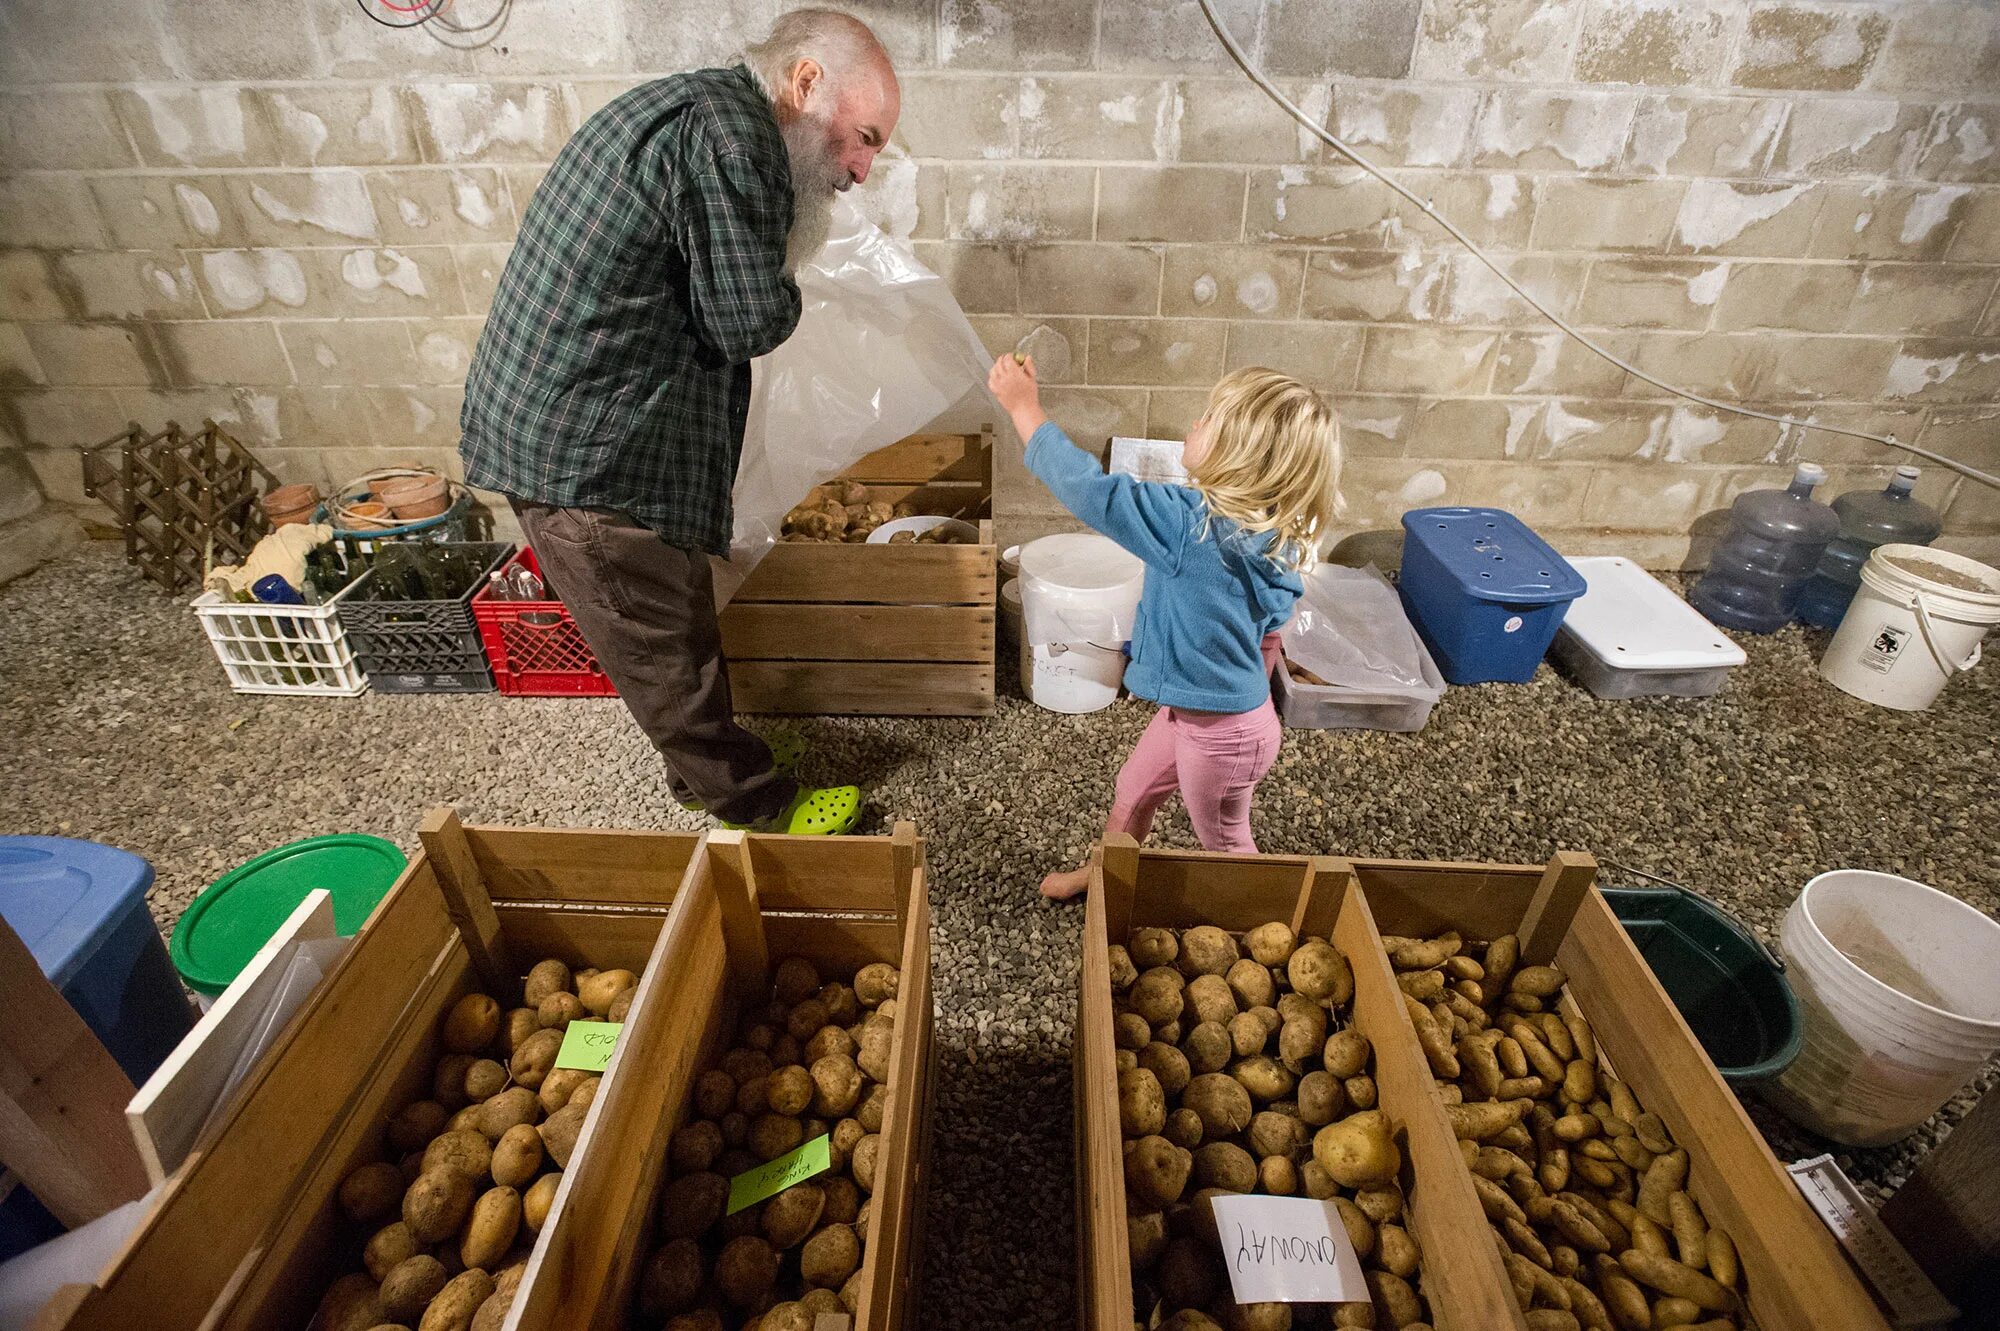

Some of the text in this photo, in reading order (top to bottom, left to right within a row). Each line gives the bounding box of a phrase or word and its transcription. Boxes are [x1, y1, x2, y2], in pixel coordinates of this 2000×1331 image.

[583, 1033, 620, 1048] OLD
[777, 1163, 810, 1185] KING
[1236, 1222, 1337, 1274] ONOWAY
